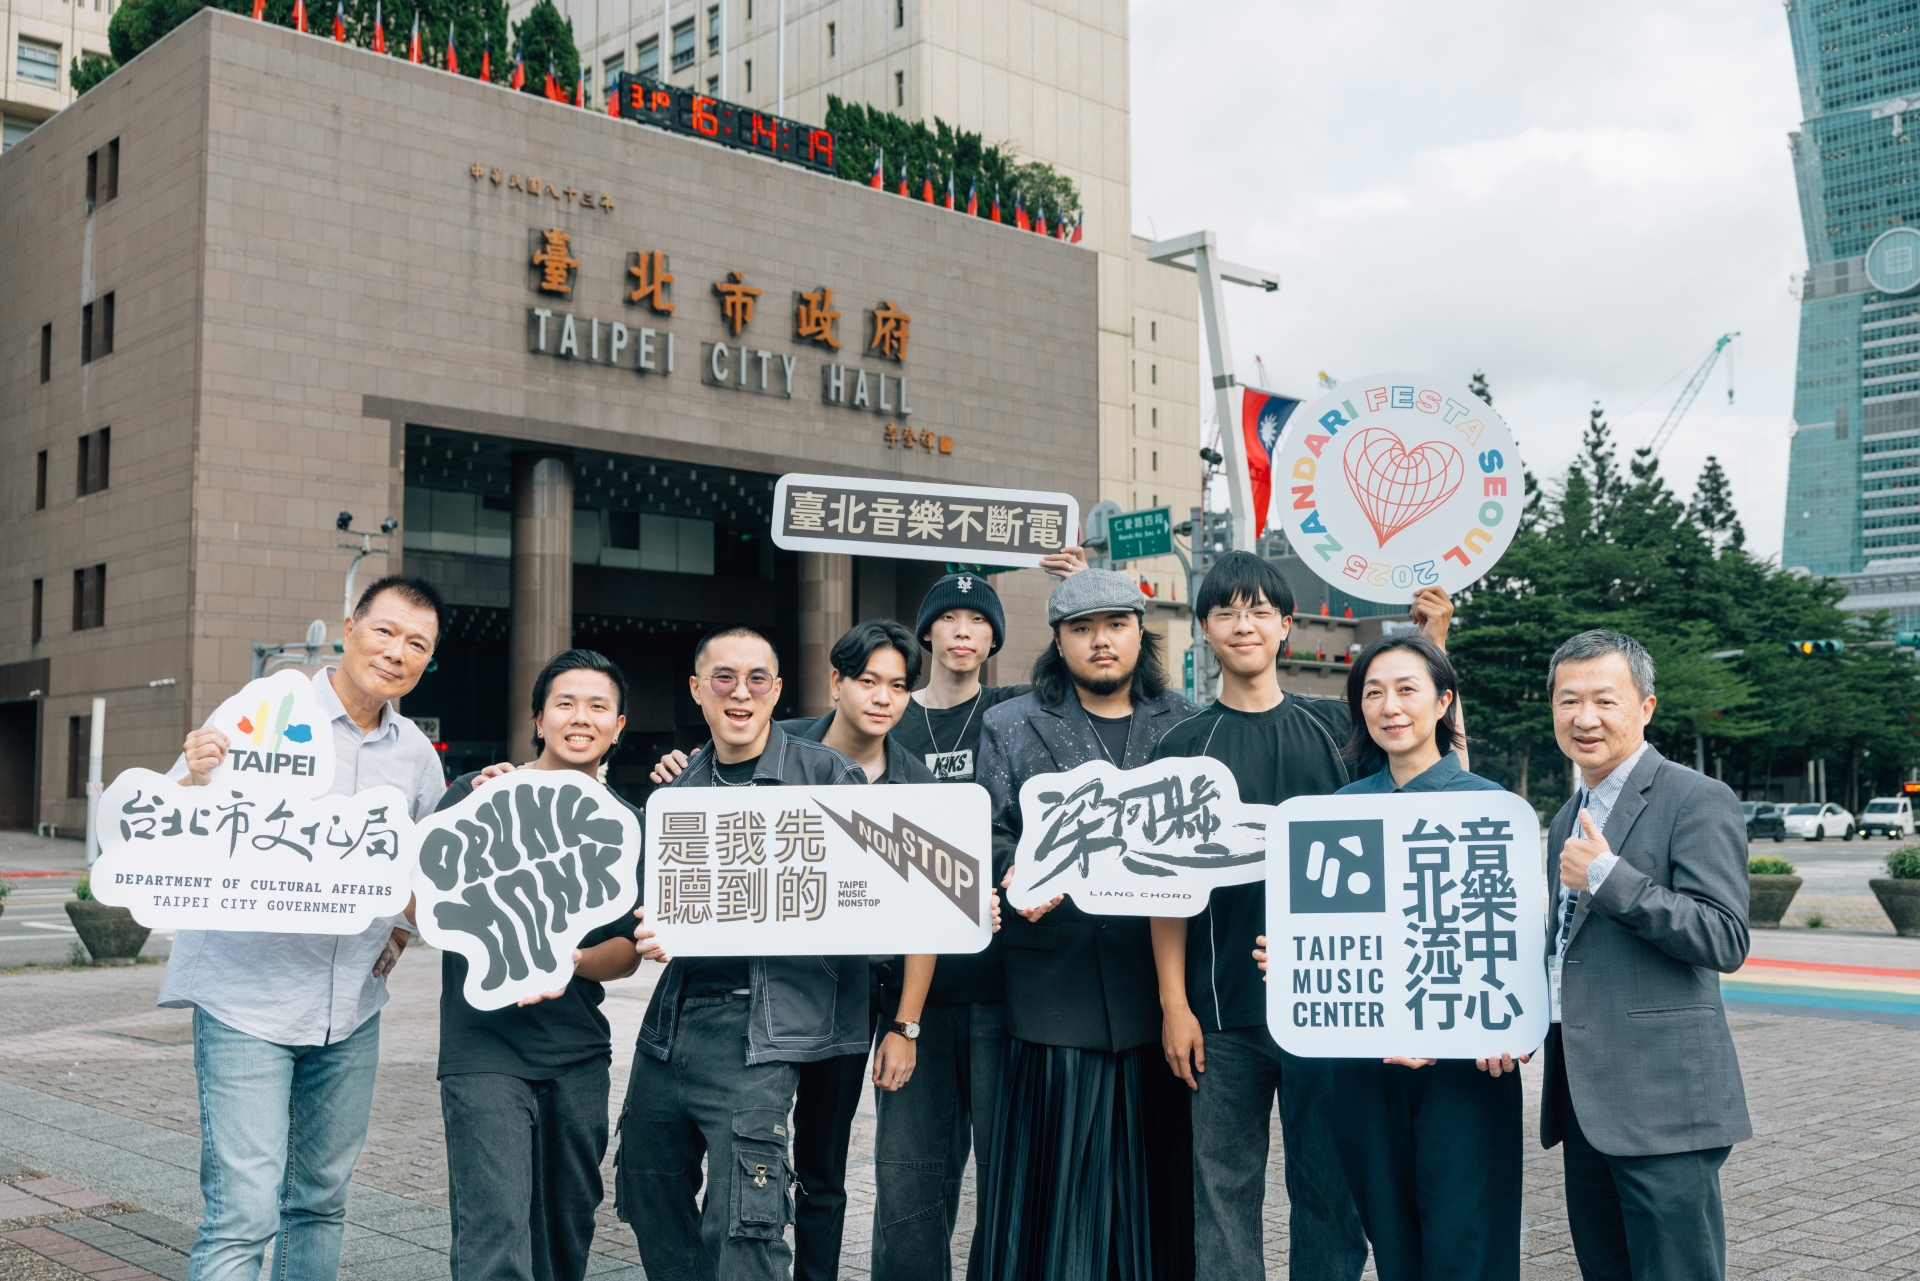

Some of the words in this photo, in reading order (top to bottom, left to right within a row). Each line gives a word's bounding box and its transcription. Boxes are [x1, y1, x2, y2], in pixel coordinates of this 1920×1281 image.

[691, 95, 833, 167] 16:14:19
[470, 163, 614, 213] 中華民國八十三年
[533, 227, 911, 361] 臺北市政府
[533, 307, 674, 373] TAIPEI
[711, 341, 797, 394] CITY
[830, 363, 913, 415] HALL
[1365, 385, 1485, 447] FESTA
[1291, 399, 1360, 562] ZANDARI
[1442, 449, 1507, 567] SEOUL
[788, 491, 1063, 549] 臺北音樂不斷電
[1342, 554, 1439, 588] 2025
[228, 749, 316, 777] TAIPEI
[120, 789, 399, 862] 台北市文化局
[419, 783, 624, 891] DRUNK
[658, 808, 827, 866] 是我先
[115, 873, 212, 888] DEPARTMENT
[222, 878, 240, 889] OF
[250, 879, 322, 893] CULTURAL
[331, 883, 392, 896] AFFAIRS
[838, 880, 867, 889] TAIPEI
[858, 820, 900, 867] NON
[901, 827, 974, 898] STOP
[153, 895, 209, 908] TAIPEI
[220, 898, 257, 910] CITY
[267, 900, 356, 914] GOVERNMENT
[657, 866, 827, 925] 聽到的
[837, 899, 881, 907] NONSTOP
[838, 889, 866, 898] MUSIC
[1090, 890, 1134, 898] LIANG
[1293, 935, 1383, 961] TAIPEI
[1402, 818, 1463, 1031] 台北流行
[1458, 817, 1524, 1031] 音樂中心
[1293, 968, 1384, 994] MUSIC
[1293, 1001, 1385, 1027] CENTER
